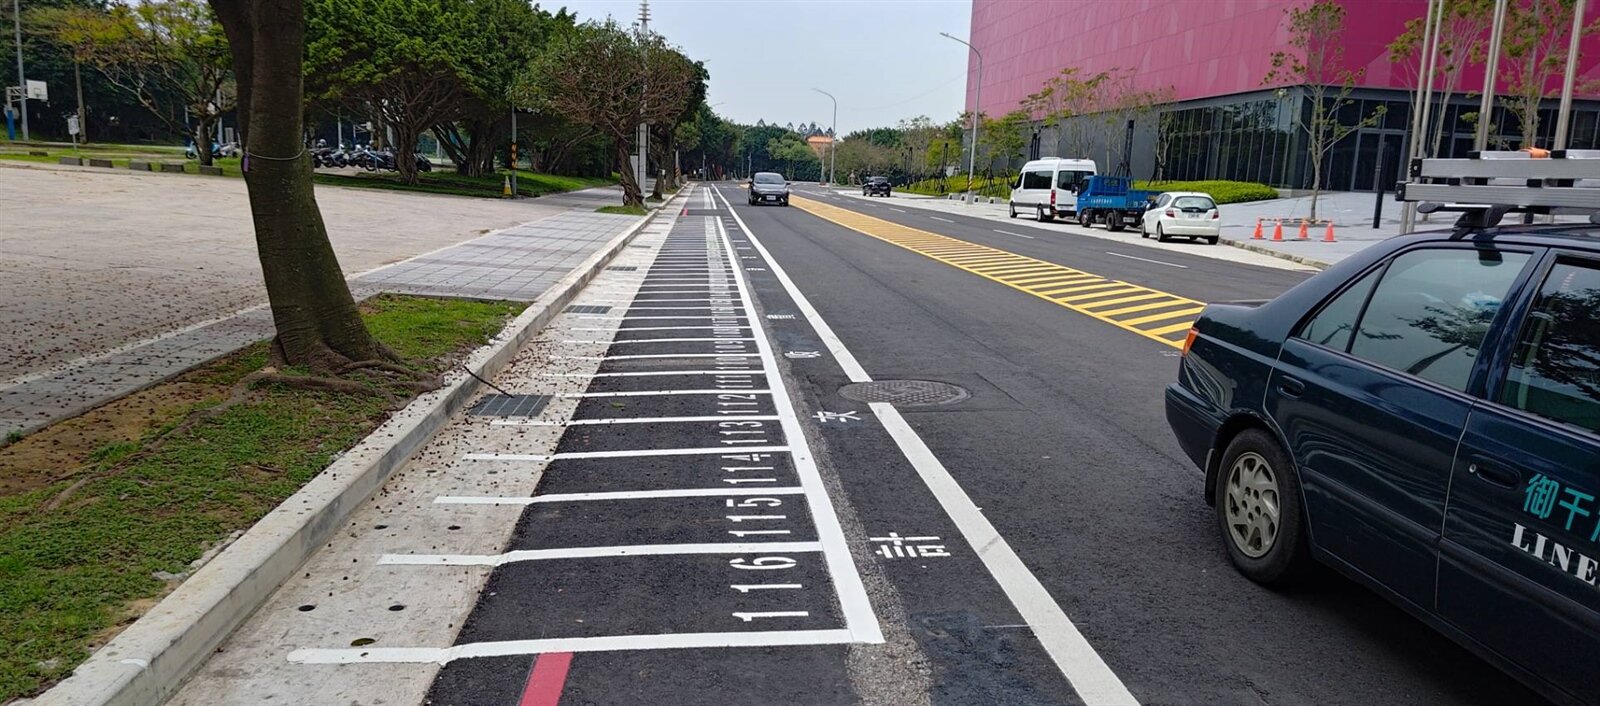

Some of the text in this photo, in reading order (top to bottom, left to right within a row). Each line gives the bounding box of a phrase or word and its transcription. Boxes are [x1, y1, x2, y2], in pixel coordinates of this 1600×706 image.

[715, 356, 750, 370] 110
[715, 374, 754, 389] 111
[717, 394, 760, 415] 112
[718, 421, 768, 445] 113
[721, 453, 777, 484] 114
[725, 498, 791, 538] 115
[870, 532, 951, 559] 計
[1510, 522, 1599, 586] LINE
[729, 556, 810, 623] 116
